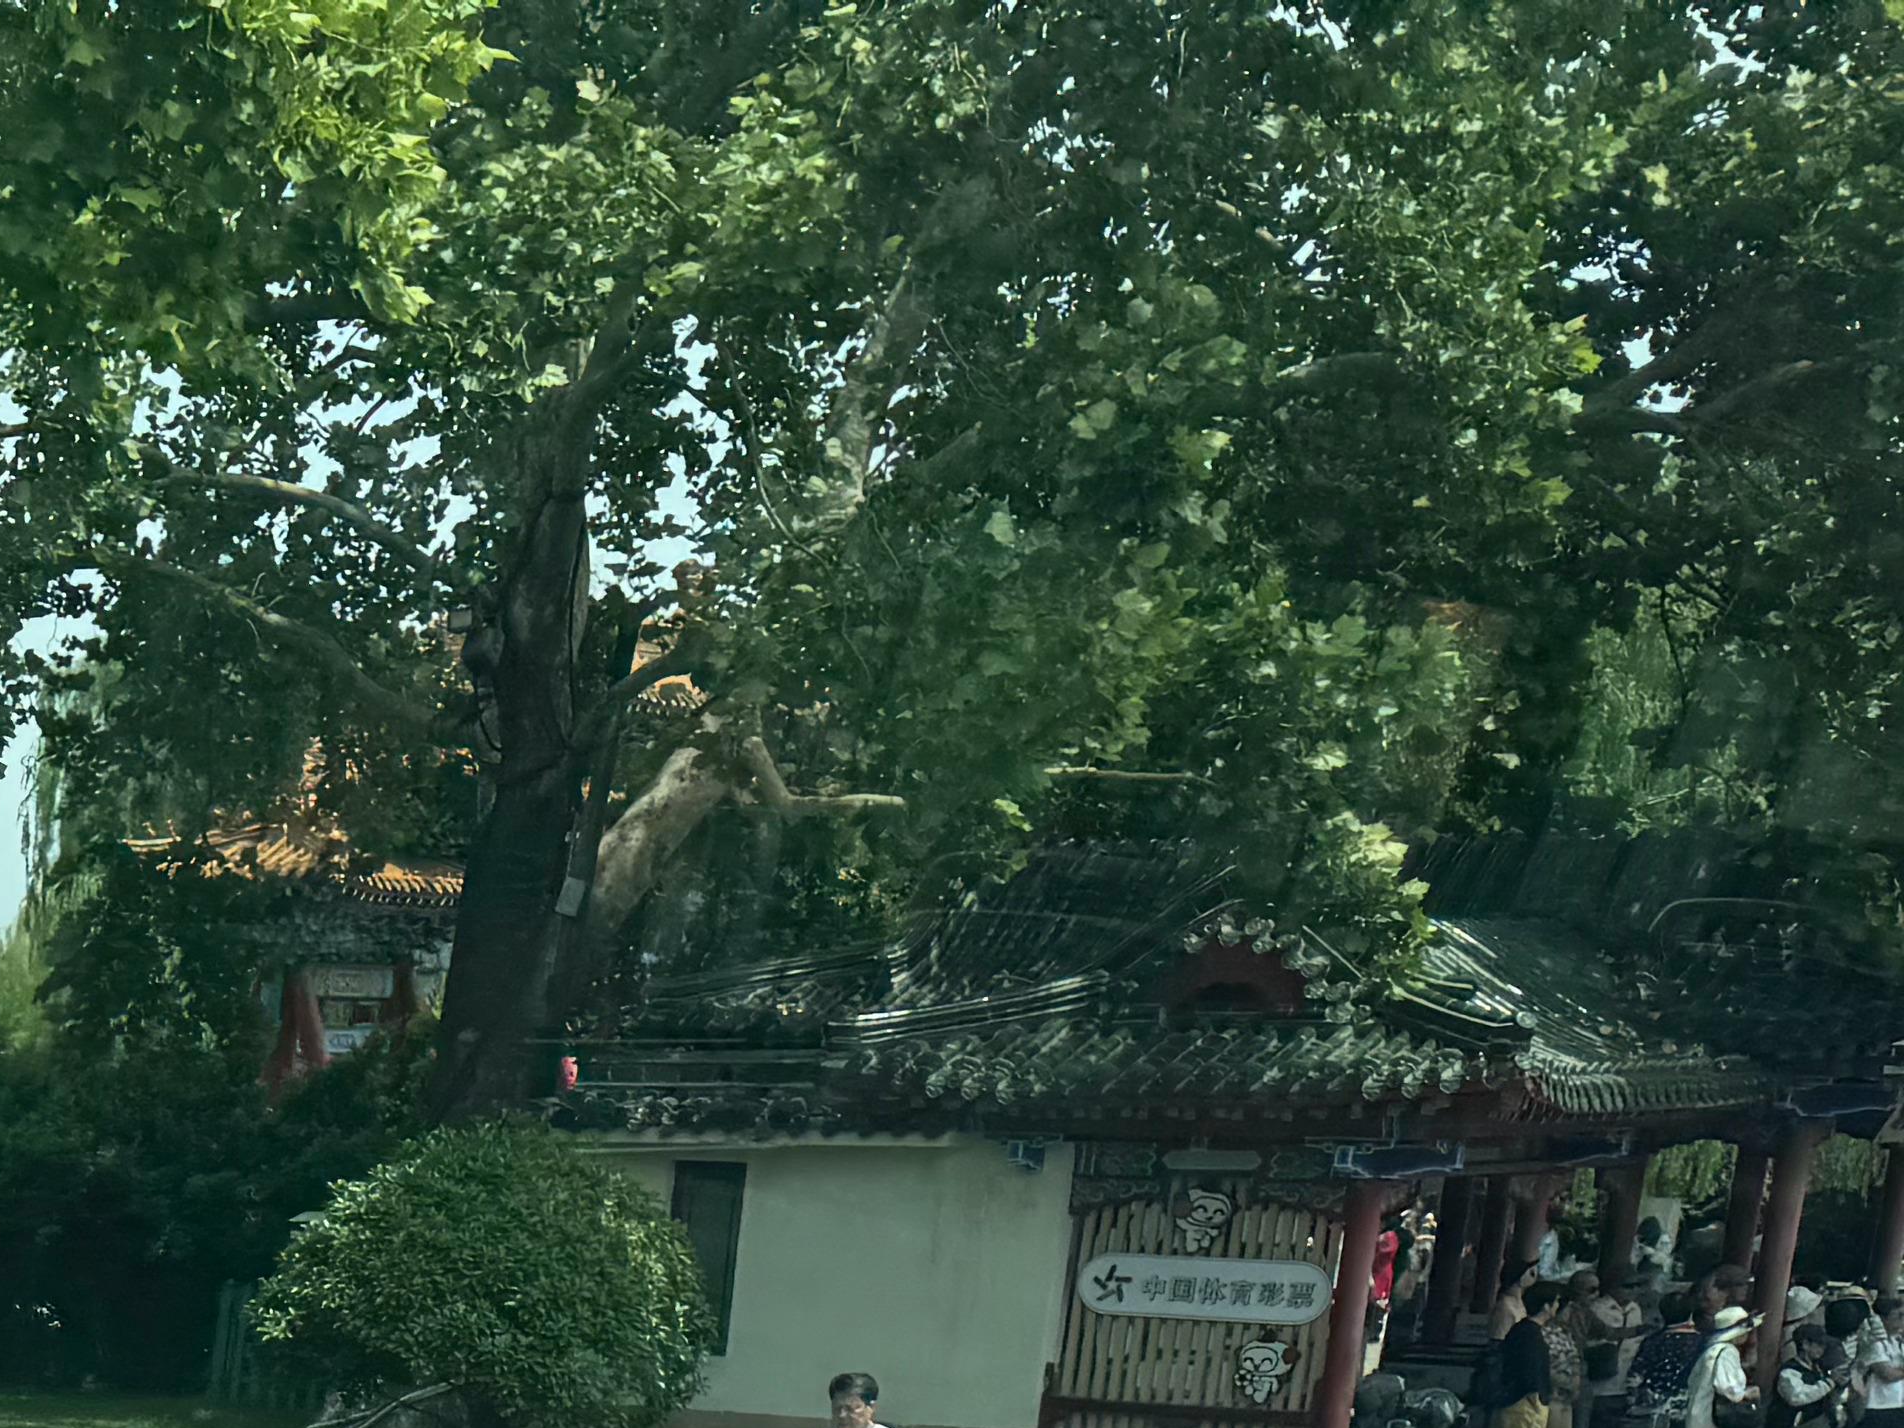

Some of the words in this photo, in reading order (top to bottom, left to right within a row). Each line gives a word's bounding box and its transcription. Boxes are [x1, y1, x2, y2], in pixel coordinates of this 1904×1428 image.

[1142, 1273, 1317, 1310] 中国体育彩票
